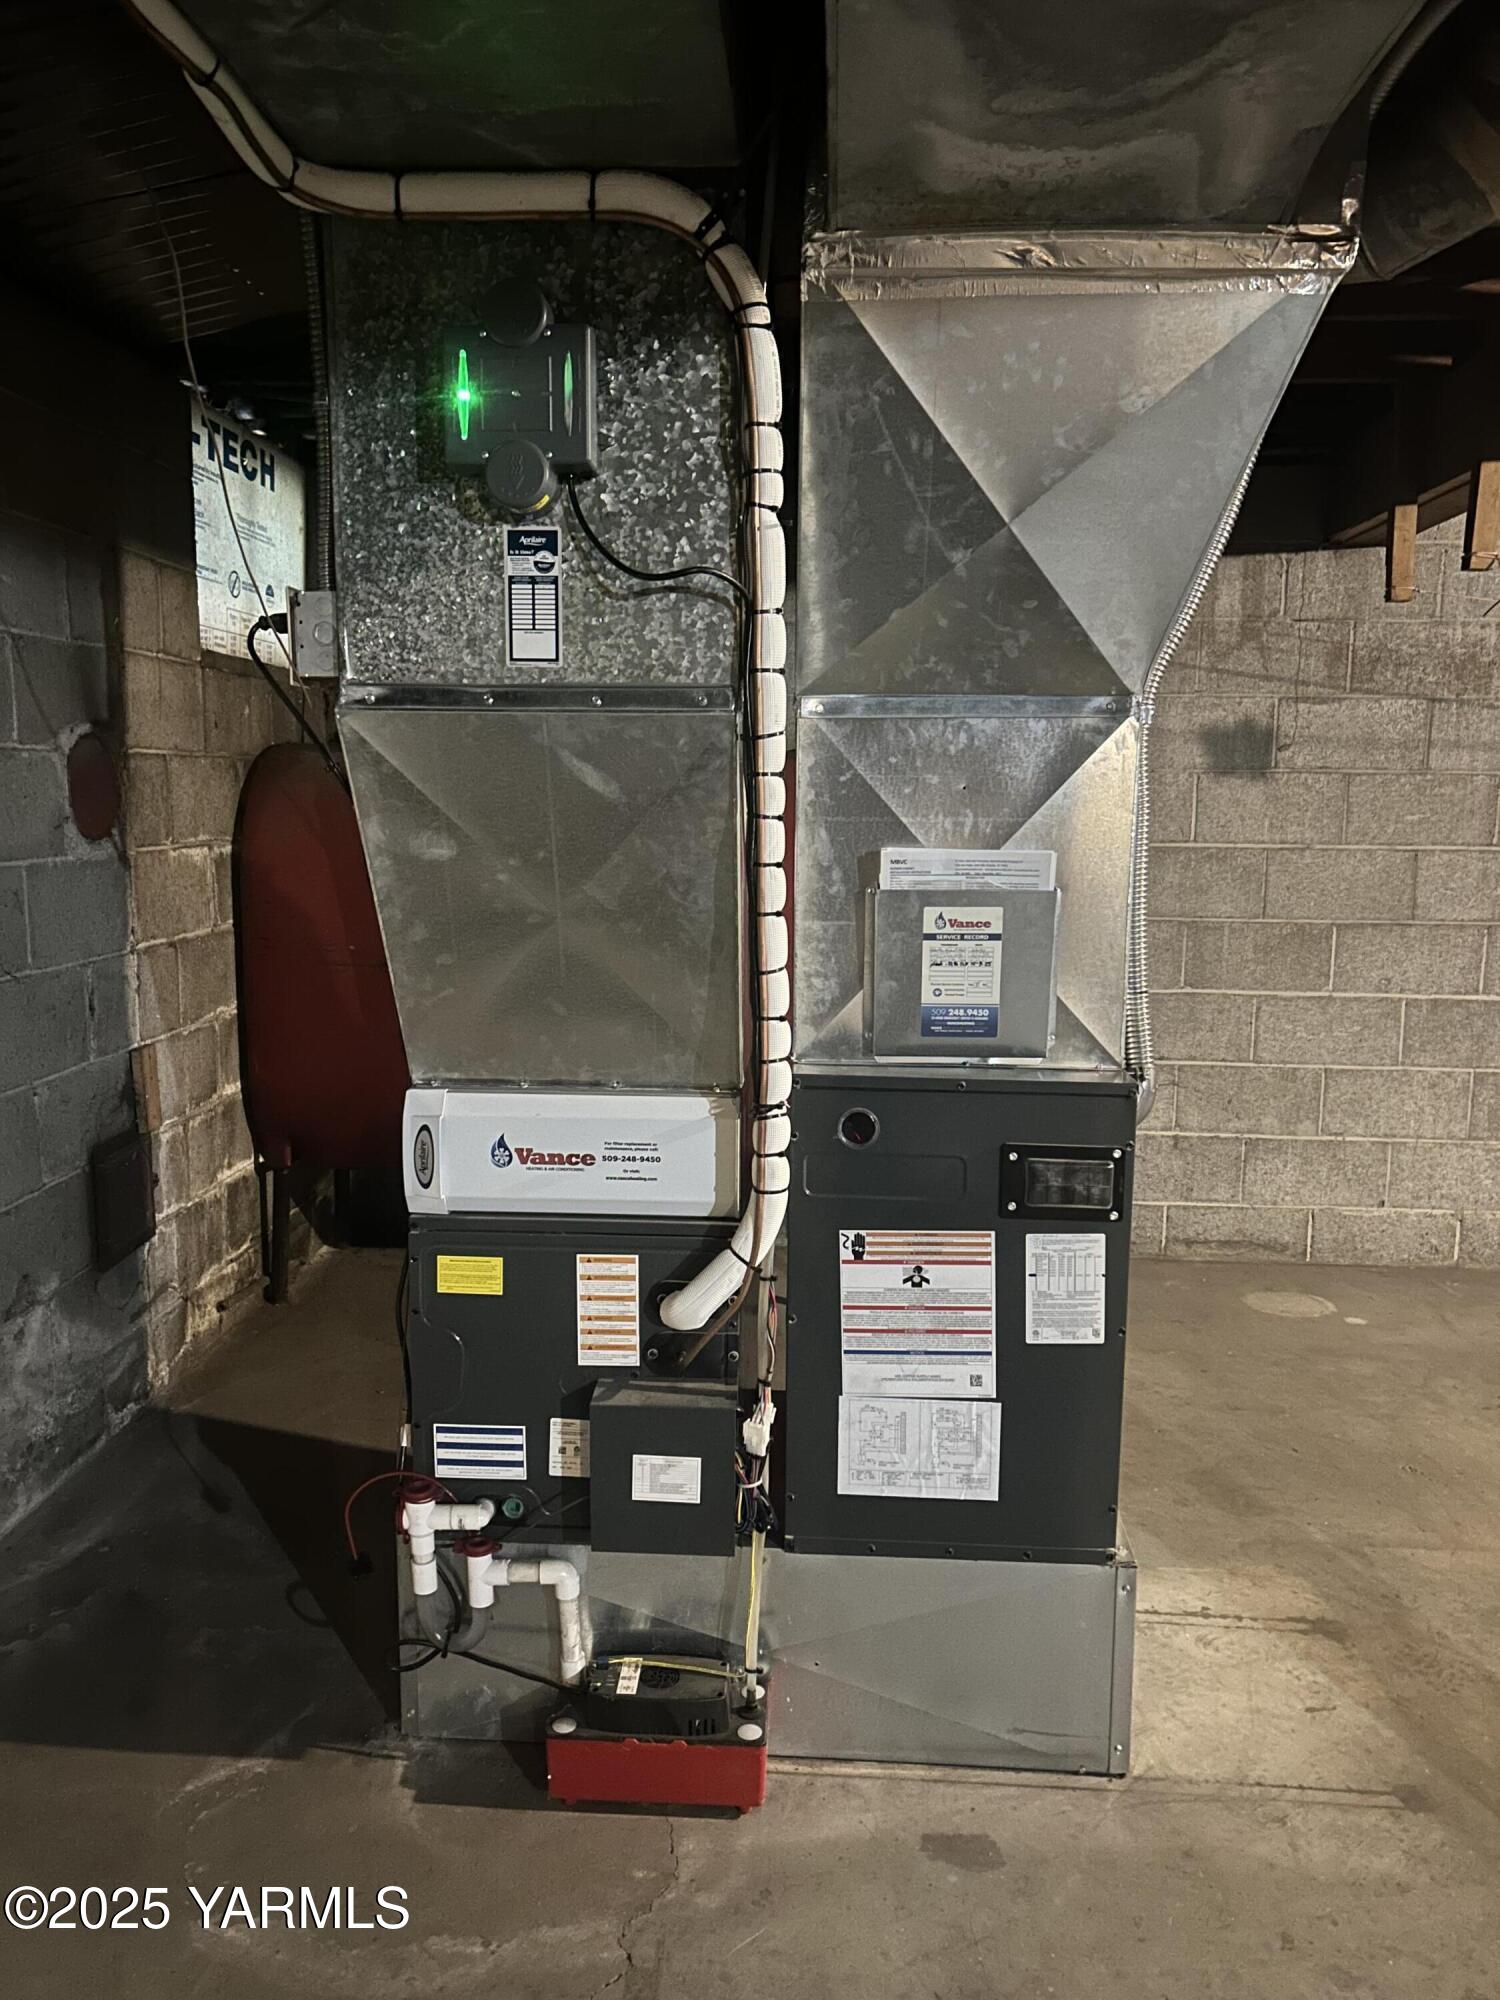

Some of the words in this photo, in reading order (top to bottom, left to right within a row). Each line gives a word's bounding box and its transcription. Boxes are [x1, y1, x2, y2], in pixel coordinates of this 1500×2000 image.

[947, 918, 992, 929] Vance
[931, 1008, 946, 1016] 509
[948, 1008, 990, 1017] 248.9450
[514, 1147, 597, 1167] Vance
[601, 1155, 662, 1163] 509-248-9450
